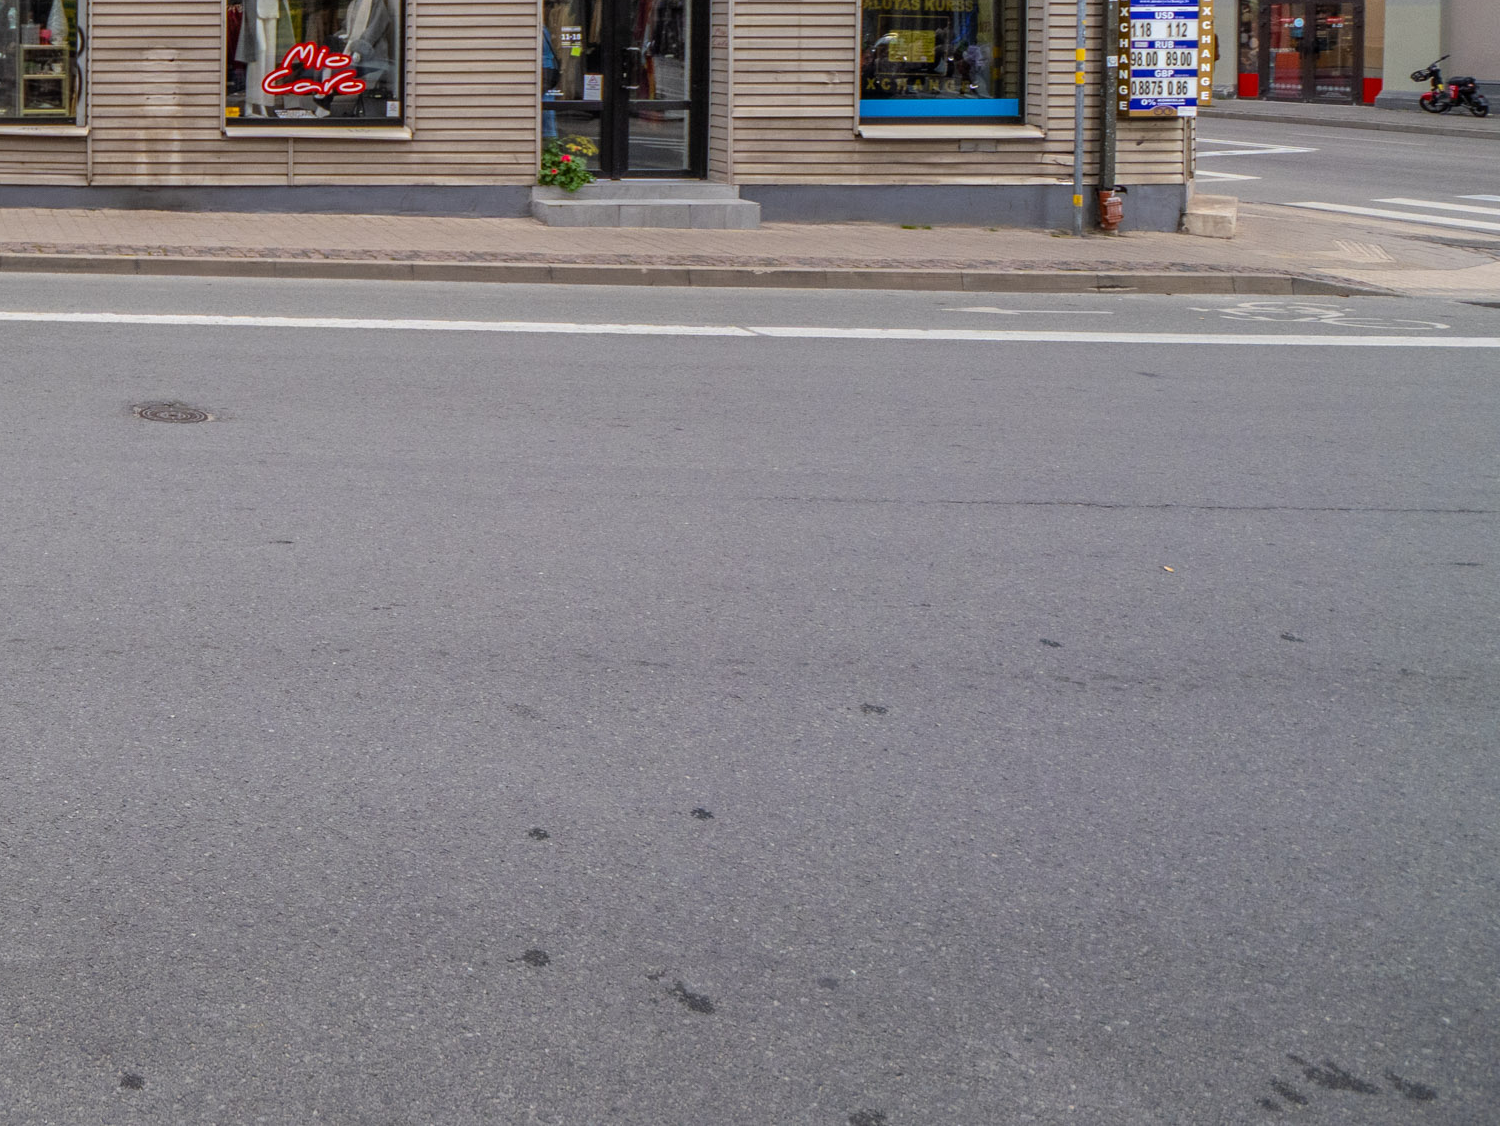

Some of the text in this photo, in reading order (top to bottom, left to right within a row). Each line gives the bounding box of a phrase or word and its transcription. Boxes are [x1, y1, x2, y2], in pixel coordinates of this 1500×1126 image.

[1131, 23, 1188, 37] 1.18 1.12
[1154, 41, 1175, 49] RUB
[281, 42, 351, 71] Mio
[1131, 52, 1192, 66] 98.00 89.00
[1154, 70, 1175, 78] GBP
[263, 68, 367, 96] Caro
[1132, 81, 1188, 95] 0.8875 0.86
